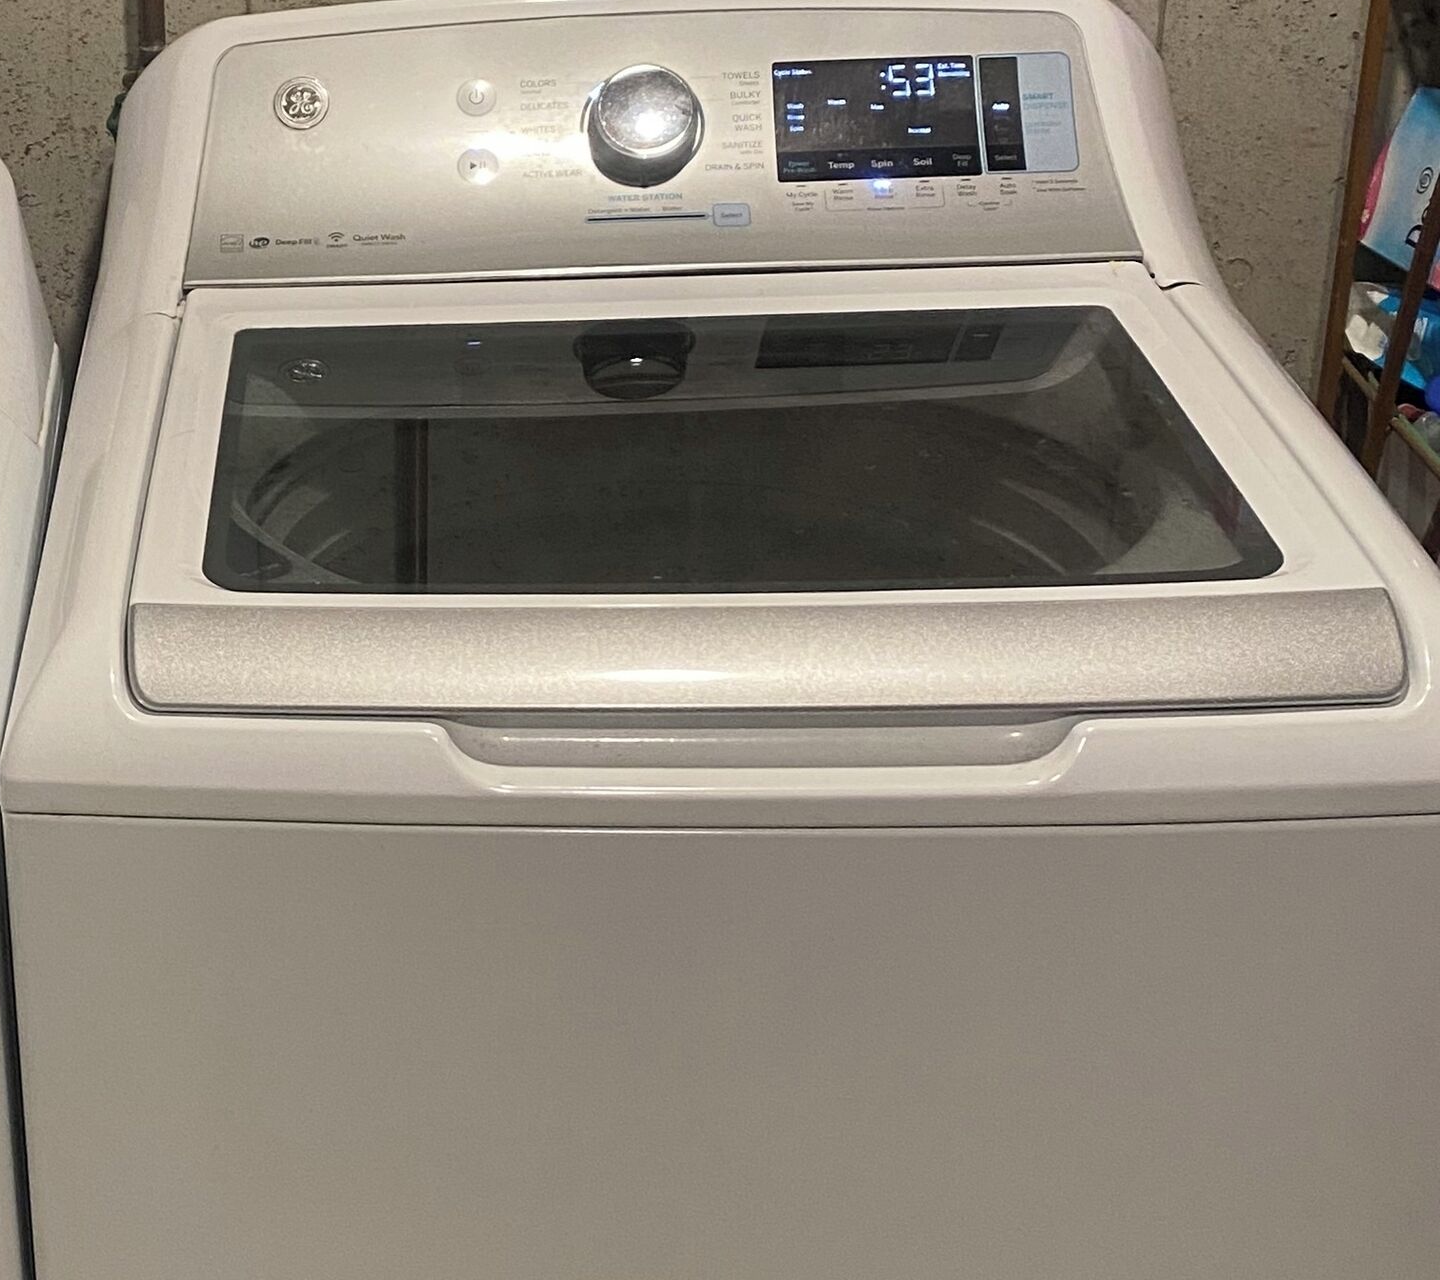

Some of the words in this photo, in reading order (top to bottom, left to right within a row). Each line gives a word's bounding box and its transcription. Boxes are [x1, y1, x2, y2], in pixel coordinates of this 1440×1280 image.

[721, 71, 760, 80] TOWELS
[520, 79, 557, 88] COLORS
[729, 91, 761, 99] BULKY
[520, 101, 569, 111] DELICATES
[732, 114, 762, 123] QUICK
[520, 125, 556, 134] WHITES
[734, 124, 762, 132] WASH
[721, 141, 763, 149] SANITIZE
[827, 161, 855, 170] Temp
[870, 159, 894, 169] Spin
[912, 157, 933, 166] Soil
[704, 163, 733, 171] DRAIN
[743, 162, 765, 170] SPIN
[642, 192, 683, 202] STATION
